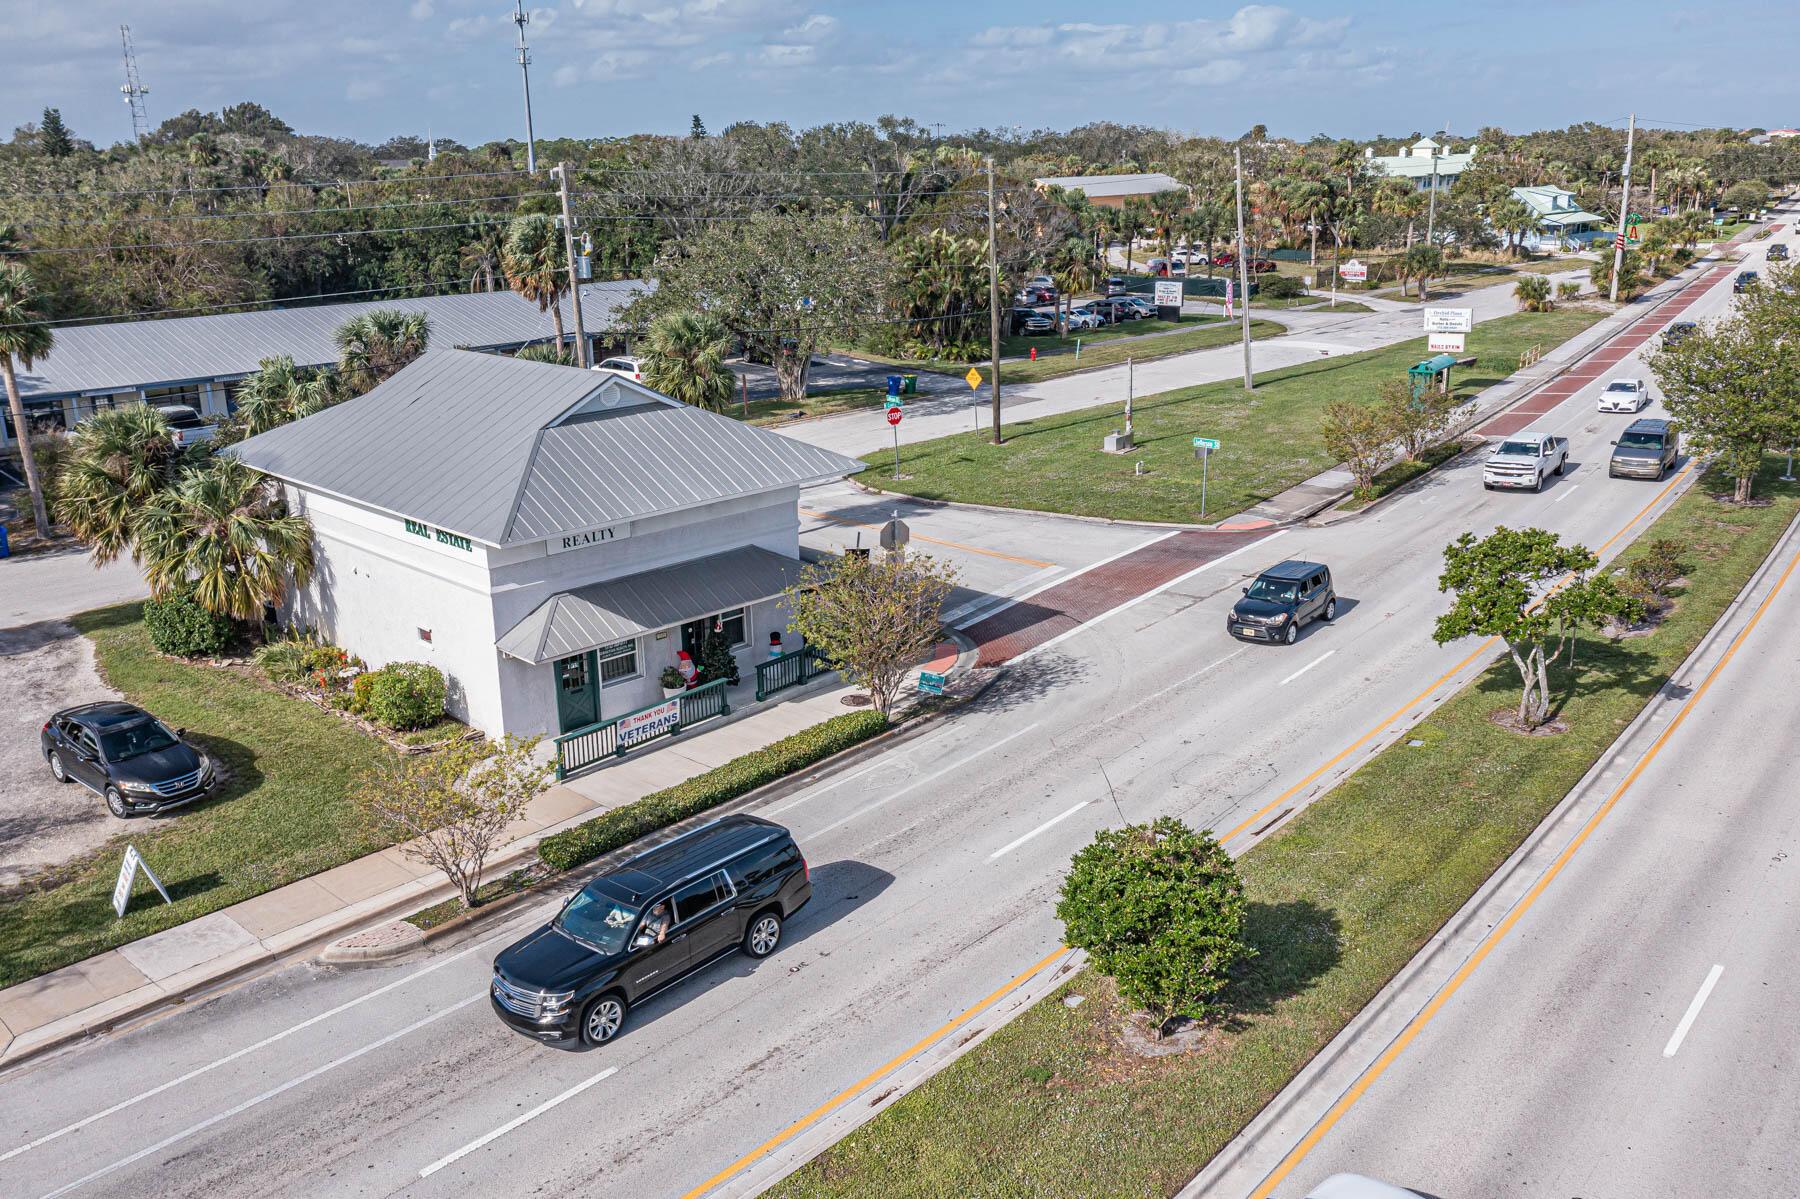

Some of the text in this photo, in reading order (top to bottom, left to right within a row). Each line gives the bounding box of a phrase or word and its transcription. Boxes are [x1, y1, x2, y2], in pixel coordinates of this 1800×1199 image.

[888, 411, 903, 421] STOP
[404, 518, 473, 553] REAL ESTATE
[562, 526, 616, 549] REALTY
[619, 712, 678, 742] VETERANS
[633, 707, 665, 724] THANK YOU
